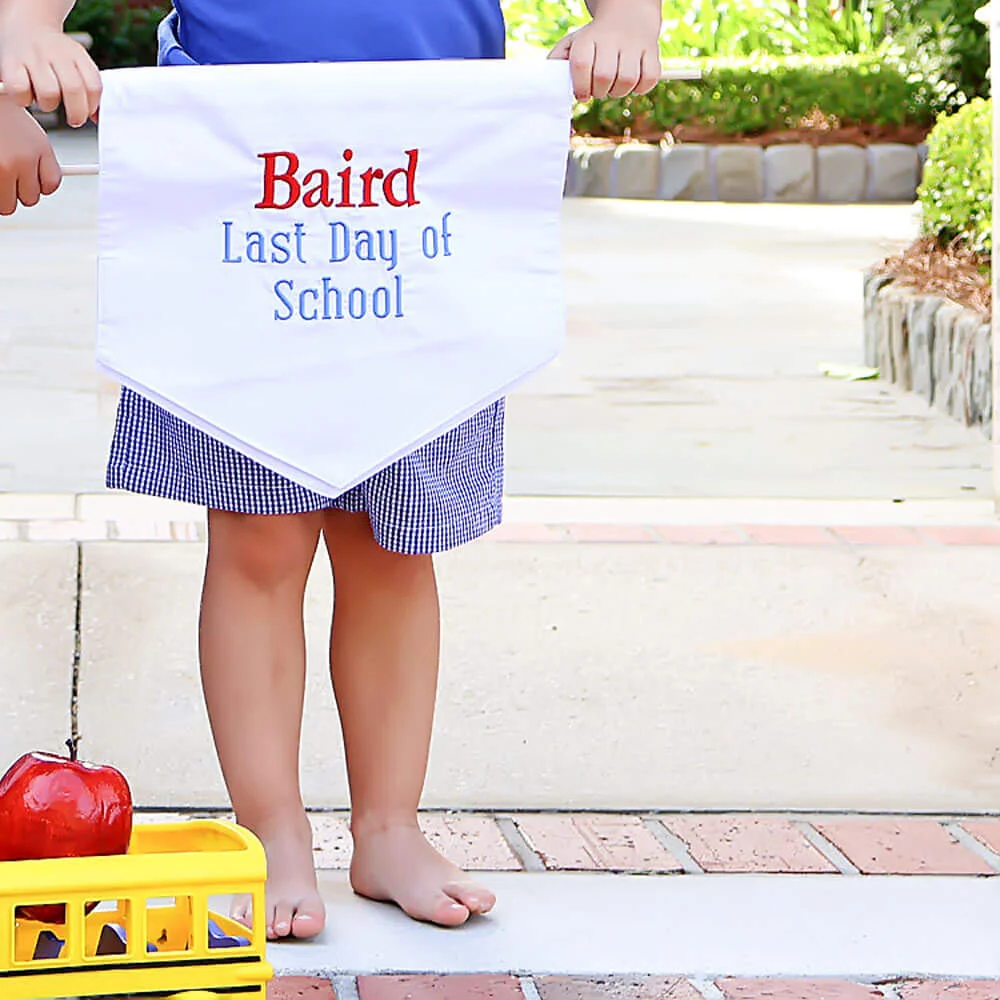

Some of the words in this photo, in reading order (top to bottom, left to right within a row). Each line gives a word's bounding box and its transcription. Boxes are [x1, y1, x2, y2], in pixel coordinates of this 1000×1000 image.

[254, 148, 421, 210] Baird
[222, 221, 307, 264] Last
[328, 221, 398, 271] Day
[421, 211, 452, 259] of
[273, 274, 404, 321] School
